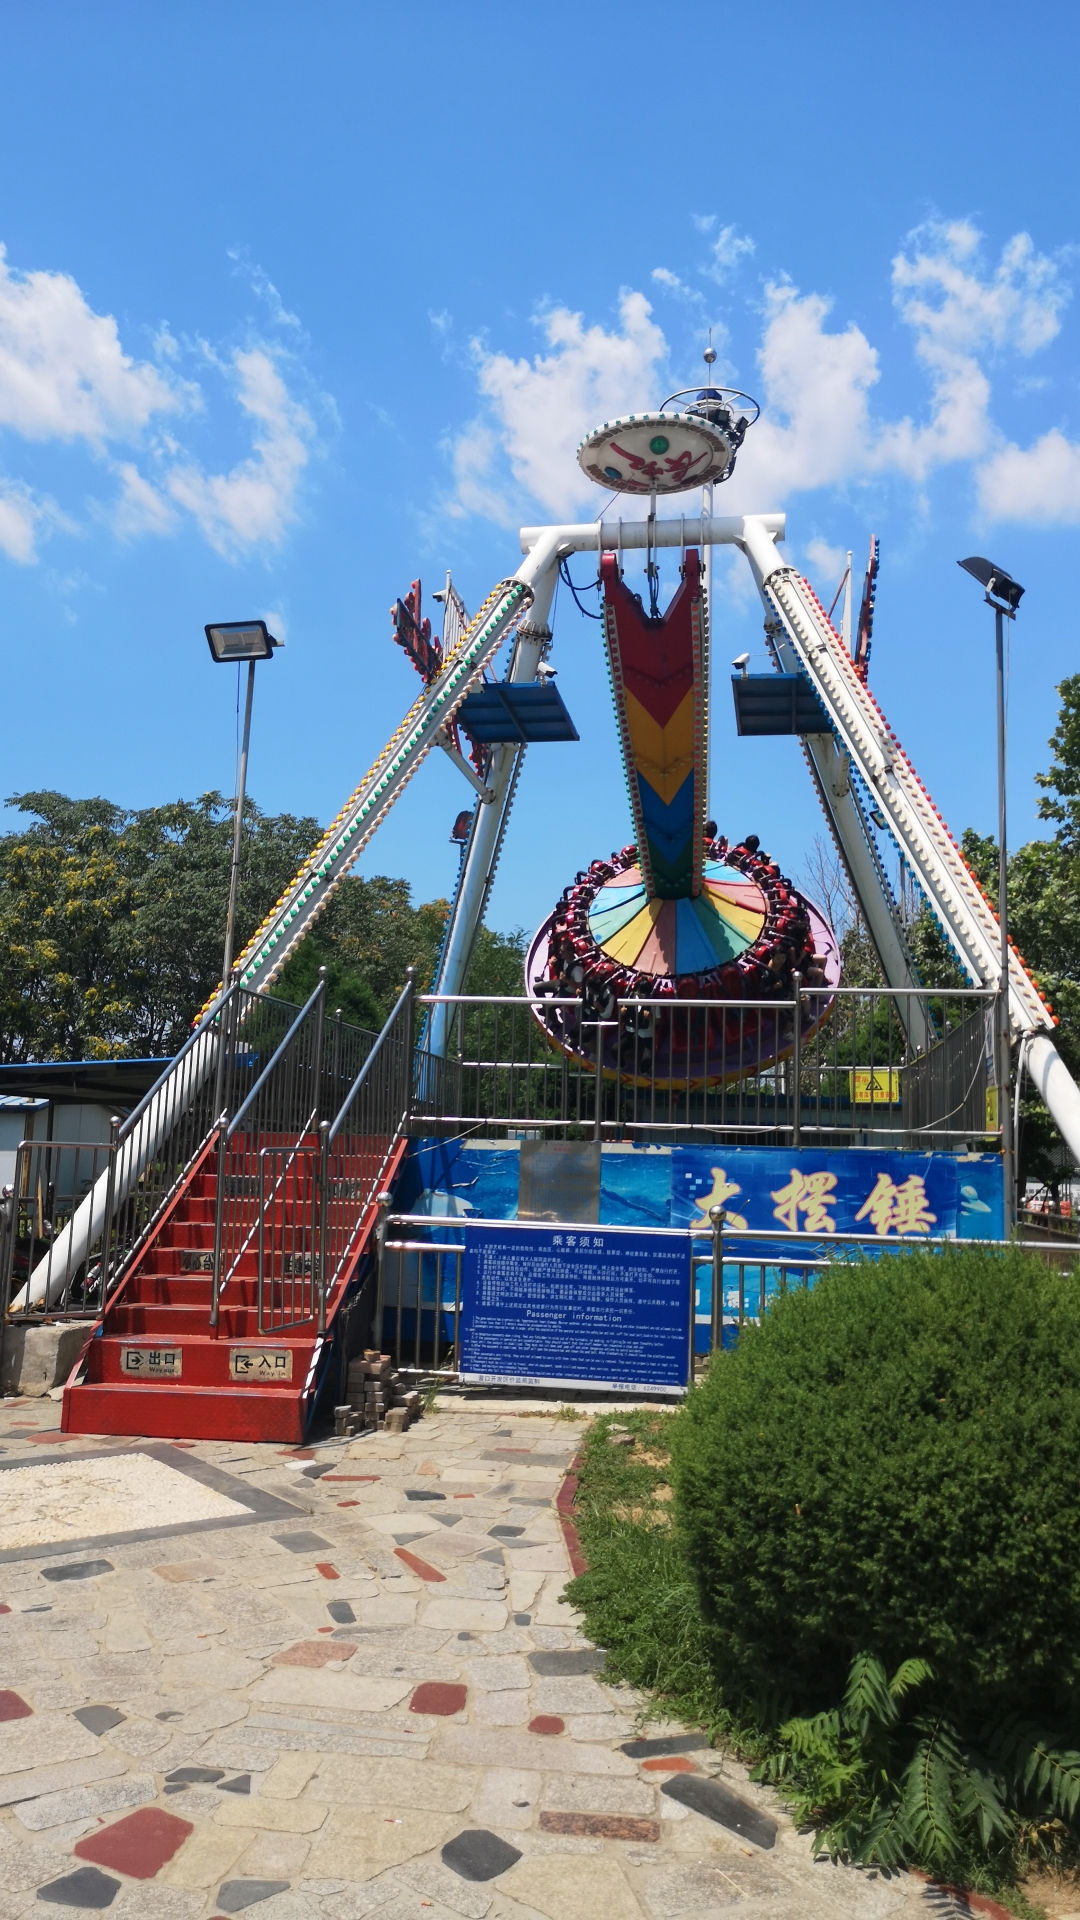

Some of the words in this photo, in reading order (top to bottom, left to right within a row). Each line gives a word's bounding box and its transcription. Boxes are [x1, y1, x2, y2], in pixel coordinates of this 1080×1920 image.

[690, 1167, 938, 1236] 大摆锤
[552, 1235, 604, 1248] 乘客须知
[526, 1310, 567, 1320] Passenger
[572, 1313, 622, 1322] information
[148, 1351, 175, 1365] 出口
[258, 1354, 286, 1368] 入口
